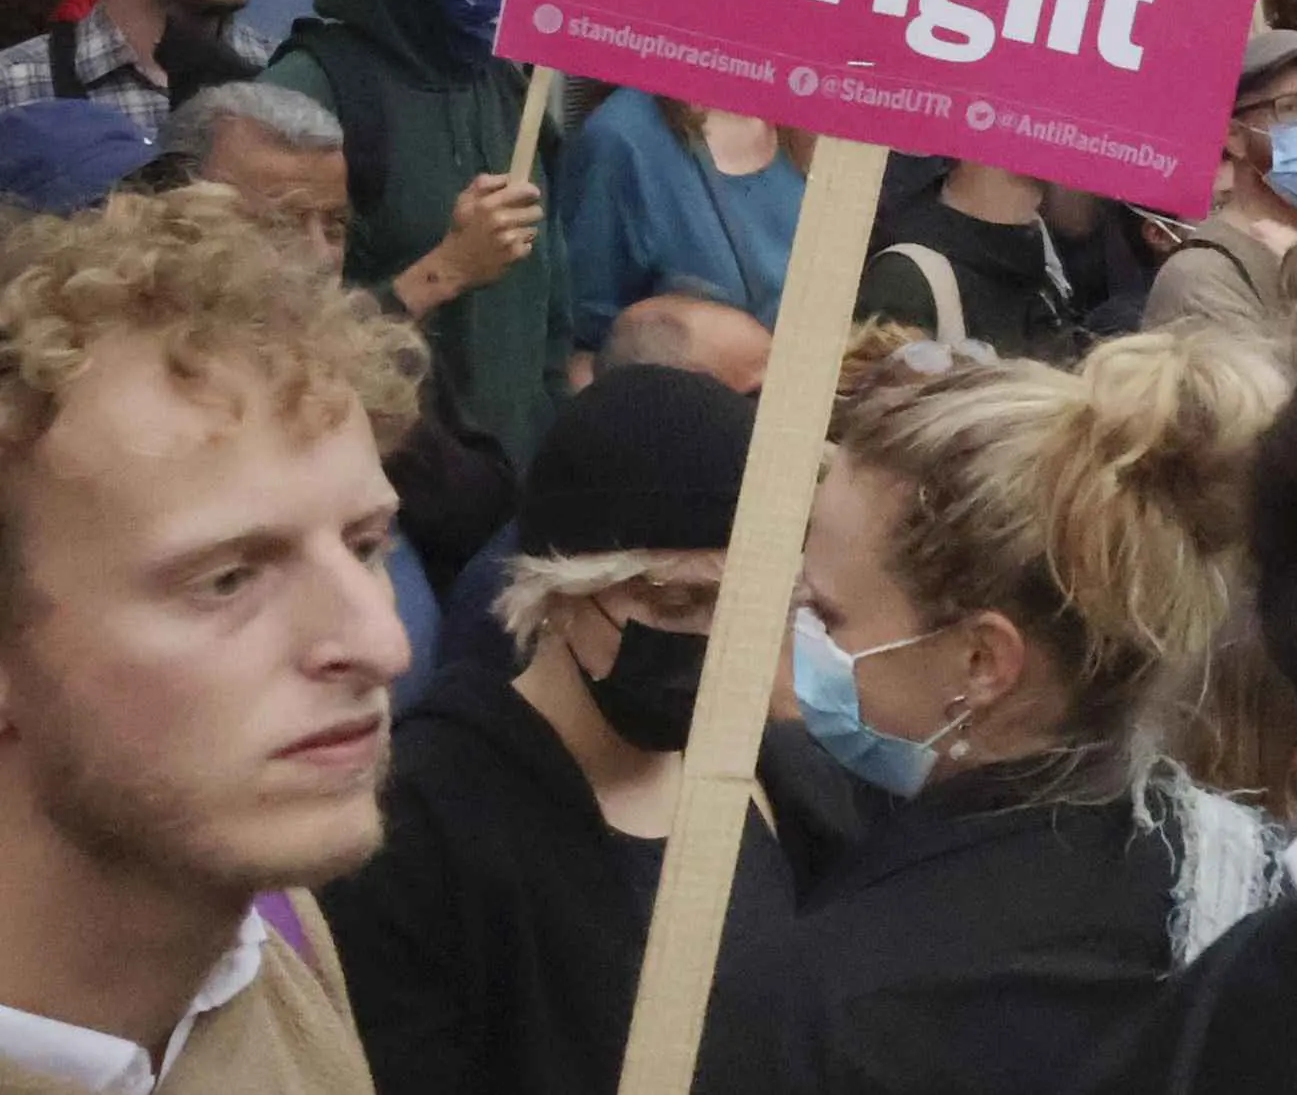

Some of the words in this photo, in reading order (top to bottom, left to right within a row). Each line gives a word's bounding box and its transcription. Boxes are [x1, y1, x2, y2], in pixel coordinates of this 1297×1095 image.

[568, 17, 777, 84] standuptoracismuk
[821, 79, 953, 119] @StandUTR
[1000, 110, 1179, 177] @AntiRacismDay
